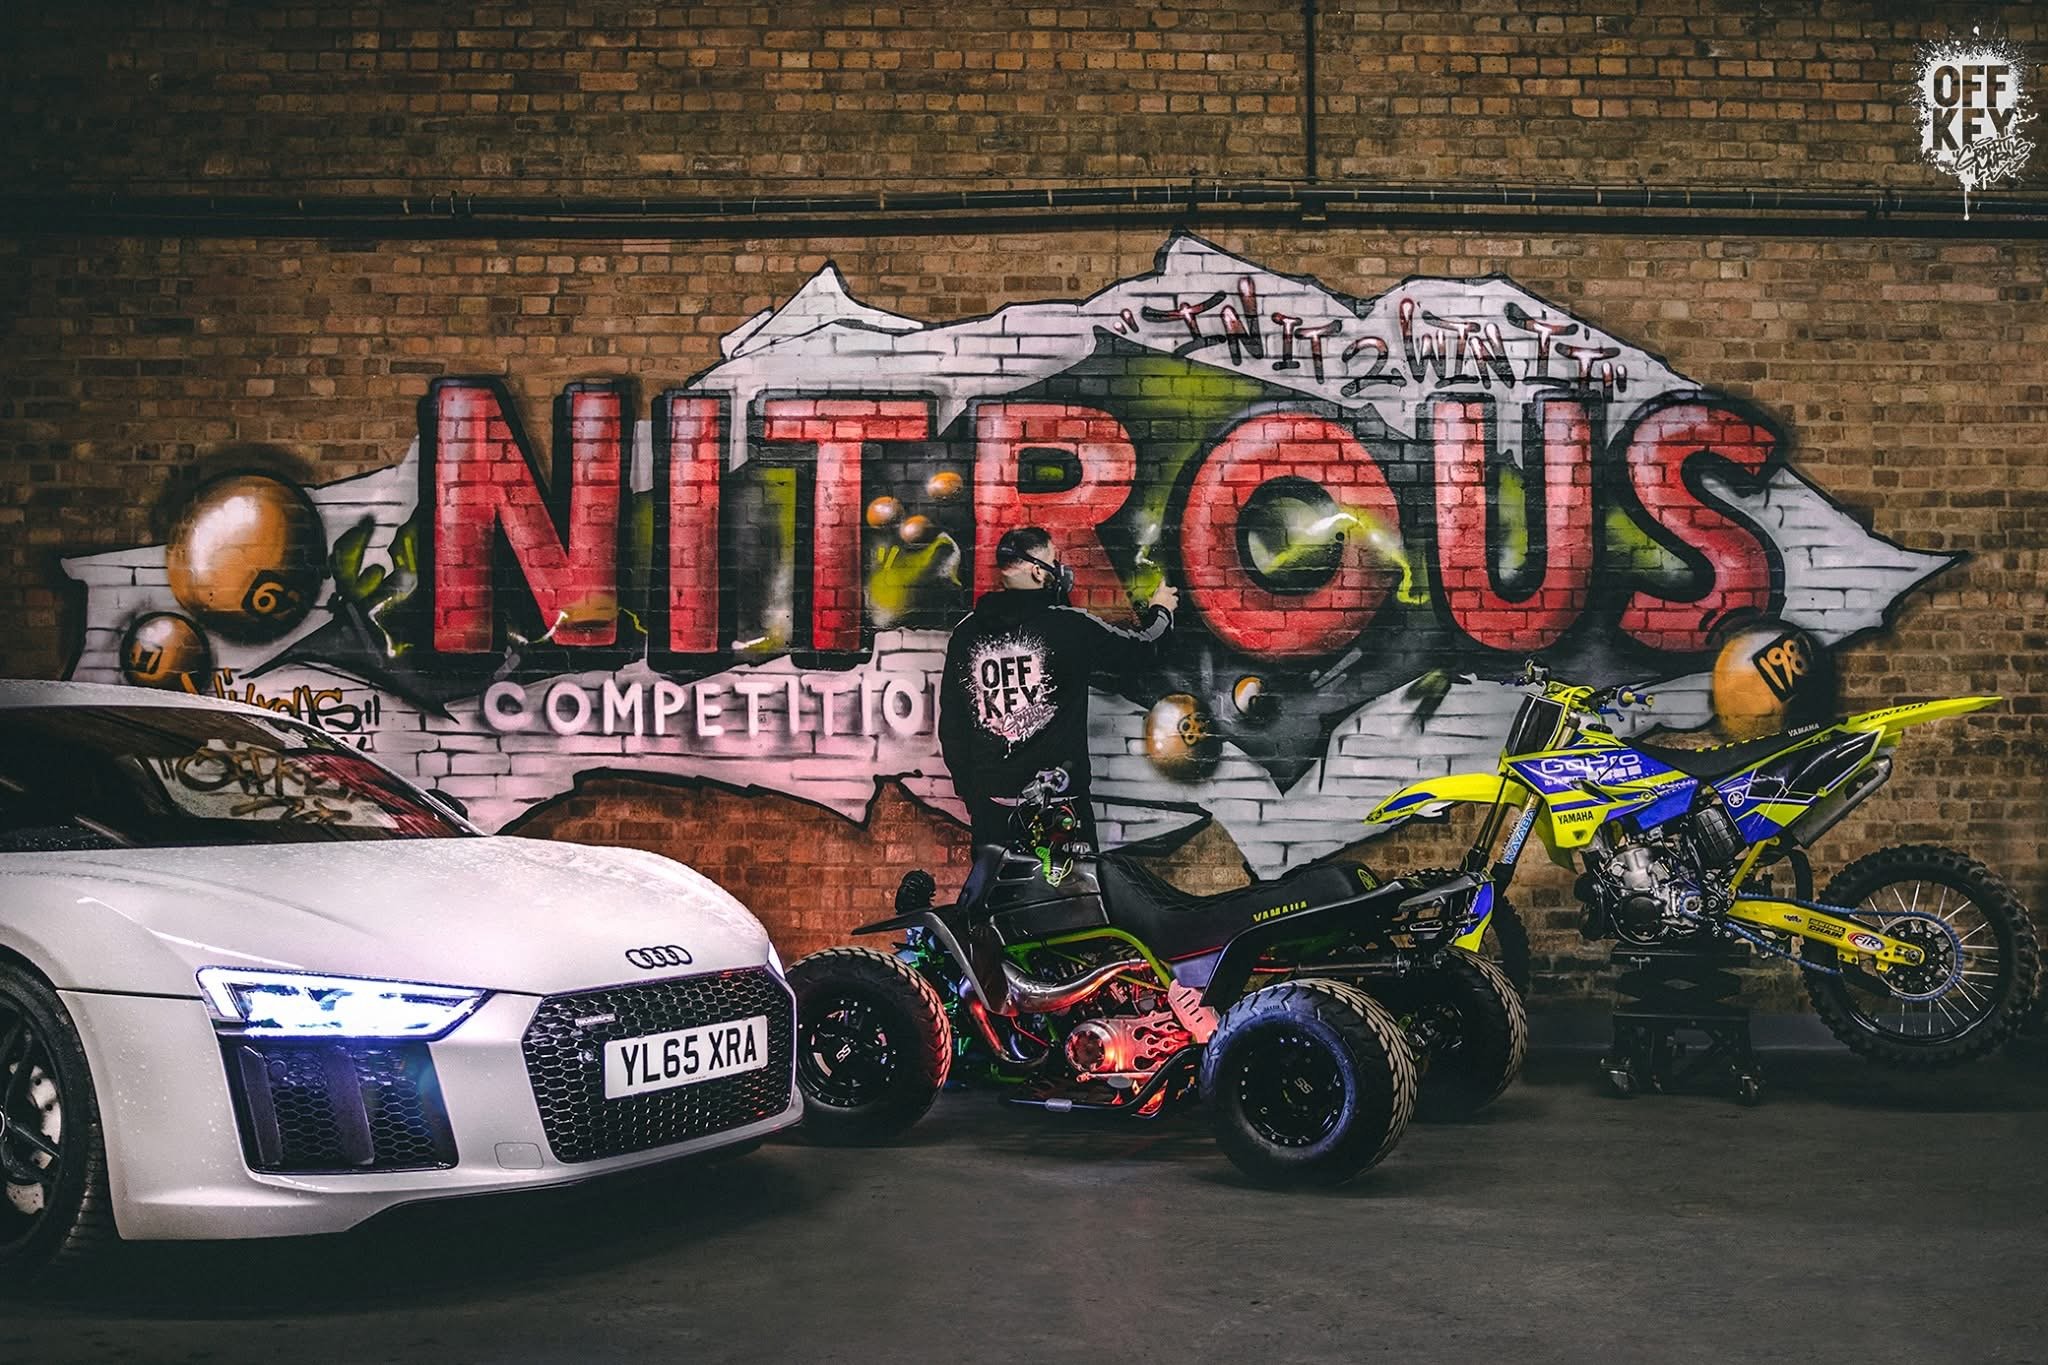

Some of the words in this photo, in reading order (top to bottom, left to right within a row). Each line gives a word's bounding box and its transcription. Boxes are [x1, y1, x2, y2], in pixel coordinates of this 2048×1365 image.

[426, 380, 1782, 659] NITROUS
[981, 655, 1033, 689] OFF
[484, 678, 942, 738] COMPETITIO
[982, 685, 1041, 718] KEY
[1787, 722, 1821, 738] YAMAHA
[1541, 753, 1640, 775] GoPro
[1557, 810, 1594, 825] YAMAHA
[1504, 807, 1538, 865] KAYABA
[1252, 900, 1308, 923] YAMAHA
[620, 1034, 700, 1086] YL65
[708, 1024, 758, 1071] XRA
